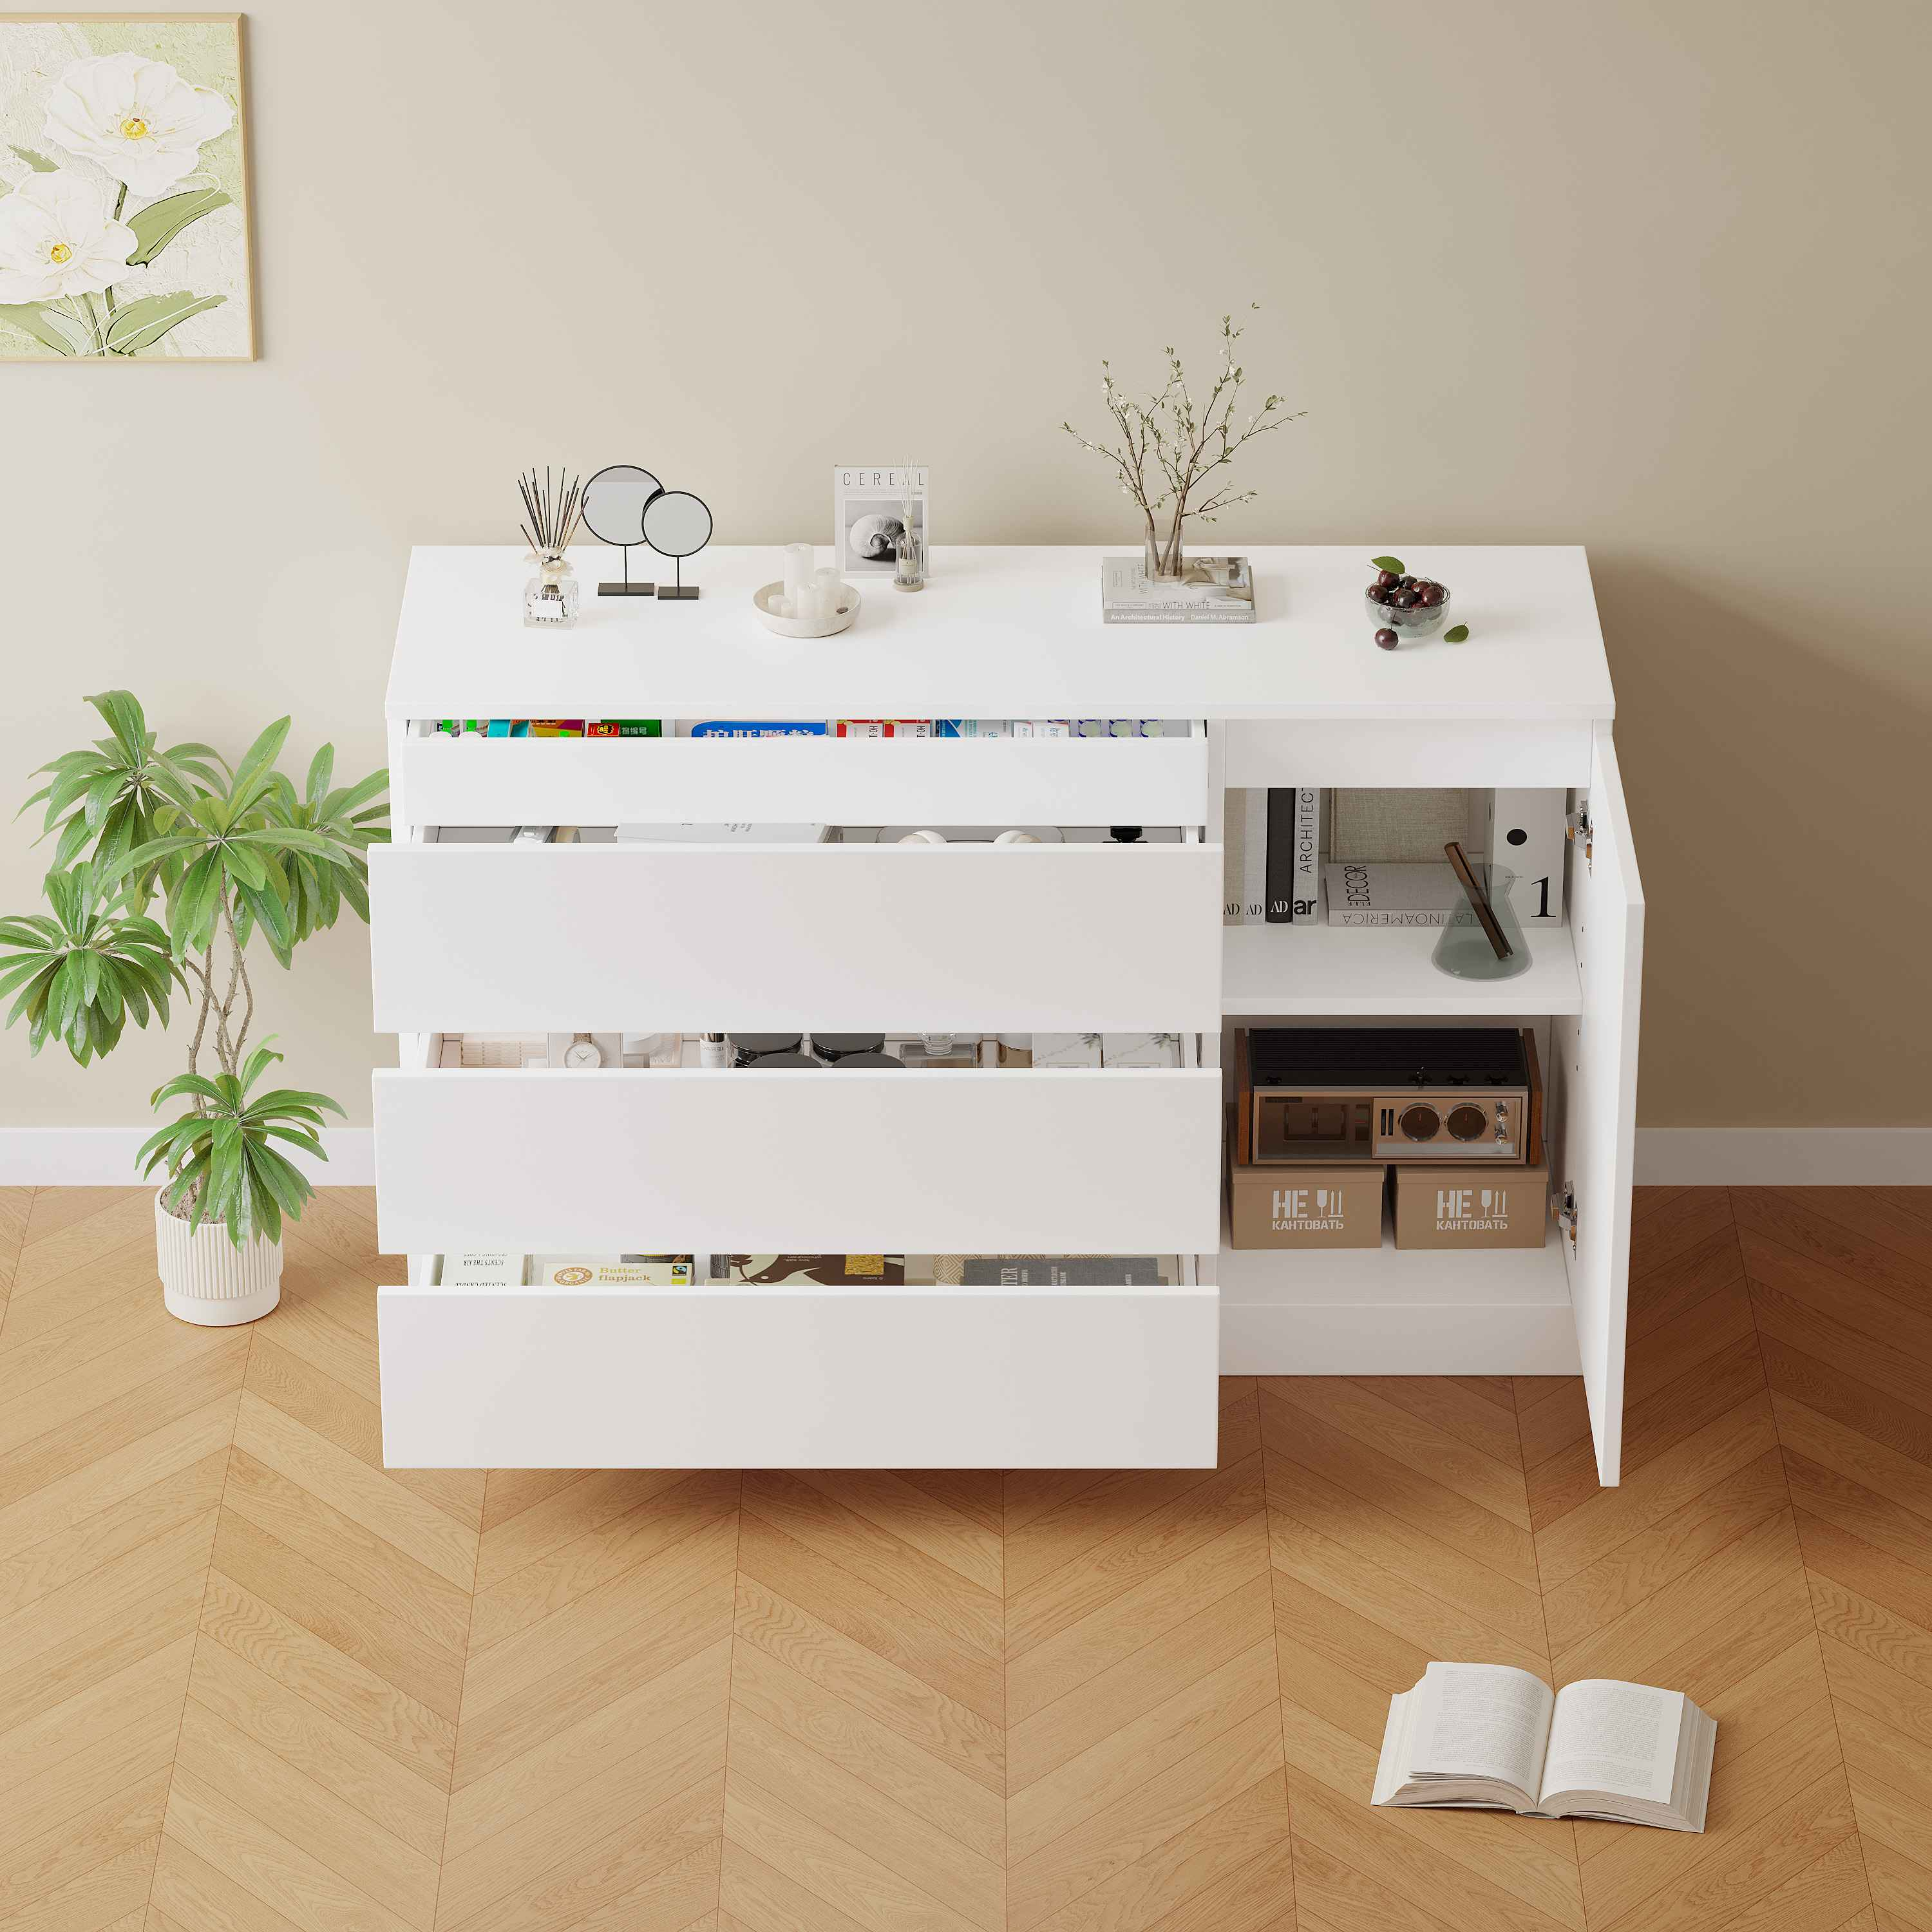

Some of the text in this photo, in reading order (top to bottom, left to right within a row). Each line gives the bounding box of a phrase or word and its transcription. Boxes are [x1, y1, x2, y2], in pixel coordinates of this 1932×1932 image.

[843, 473, 925, 486] CEREAL
[1300, 788, 1314, 873] ARCHITEC
[1345, 866, 1370, 902] DECOR
[1531, 876, 1557, 917] 1
[1223, 903, 1240, 915] AD
[1246, 904, 1262, 915] AD
[1271, 900, 1289, 913] AD
[1294, 900, 1317, 915] ar
[1342, 913, 1473, 924] LAINOAMERICA
[1273, 1190, 1308, 1218] НЕ
[1437, 1190, 1472, 1218] НЕ
[1272, 1220, 1344, 1230] КАНТОВАТЬ
[1436, 1220, 1508, 1230] КАНТОВАТЬ
